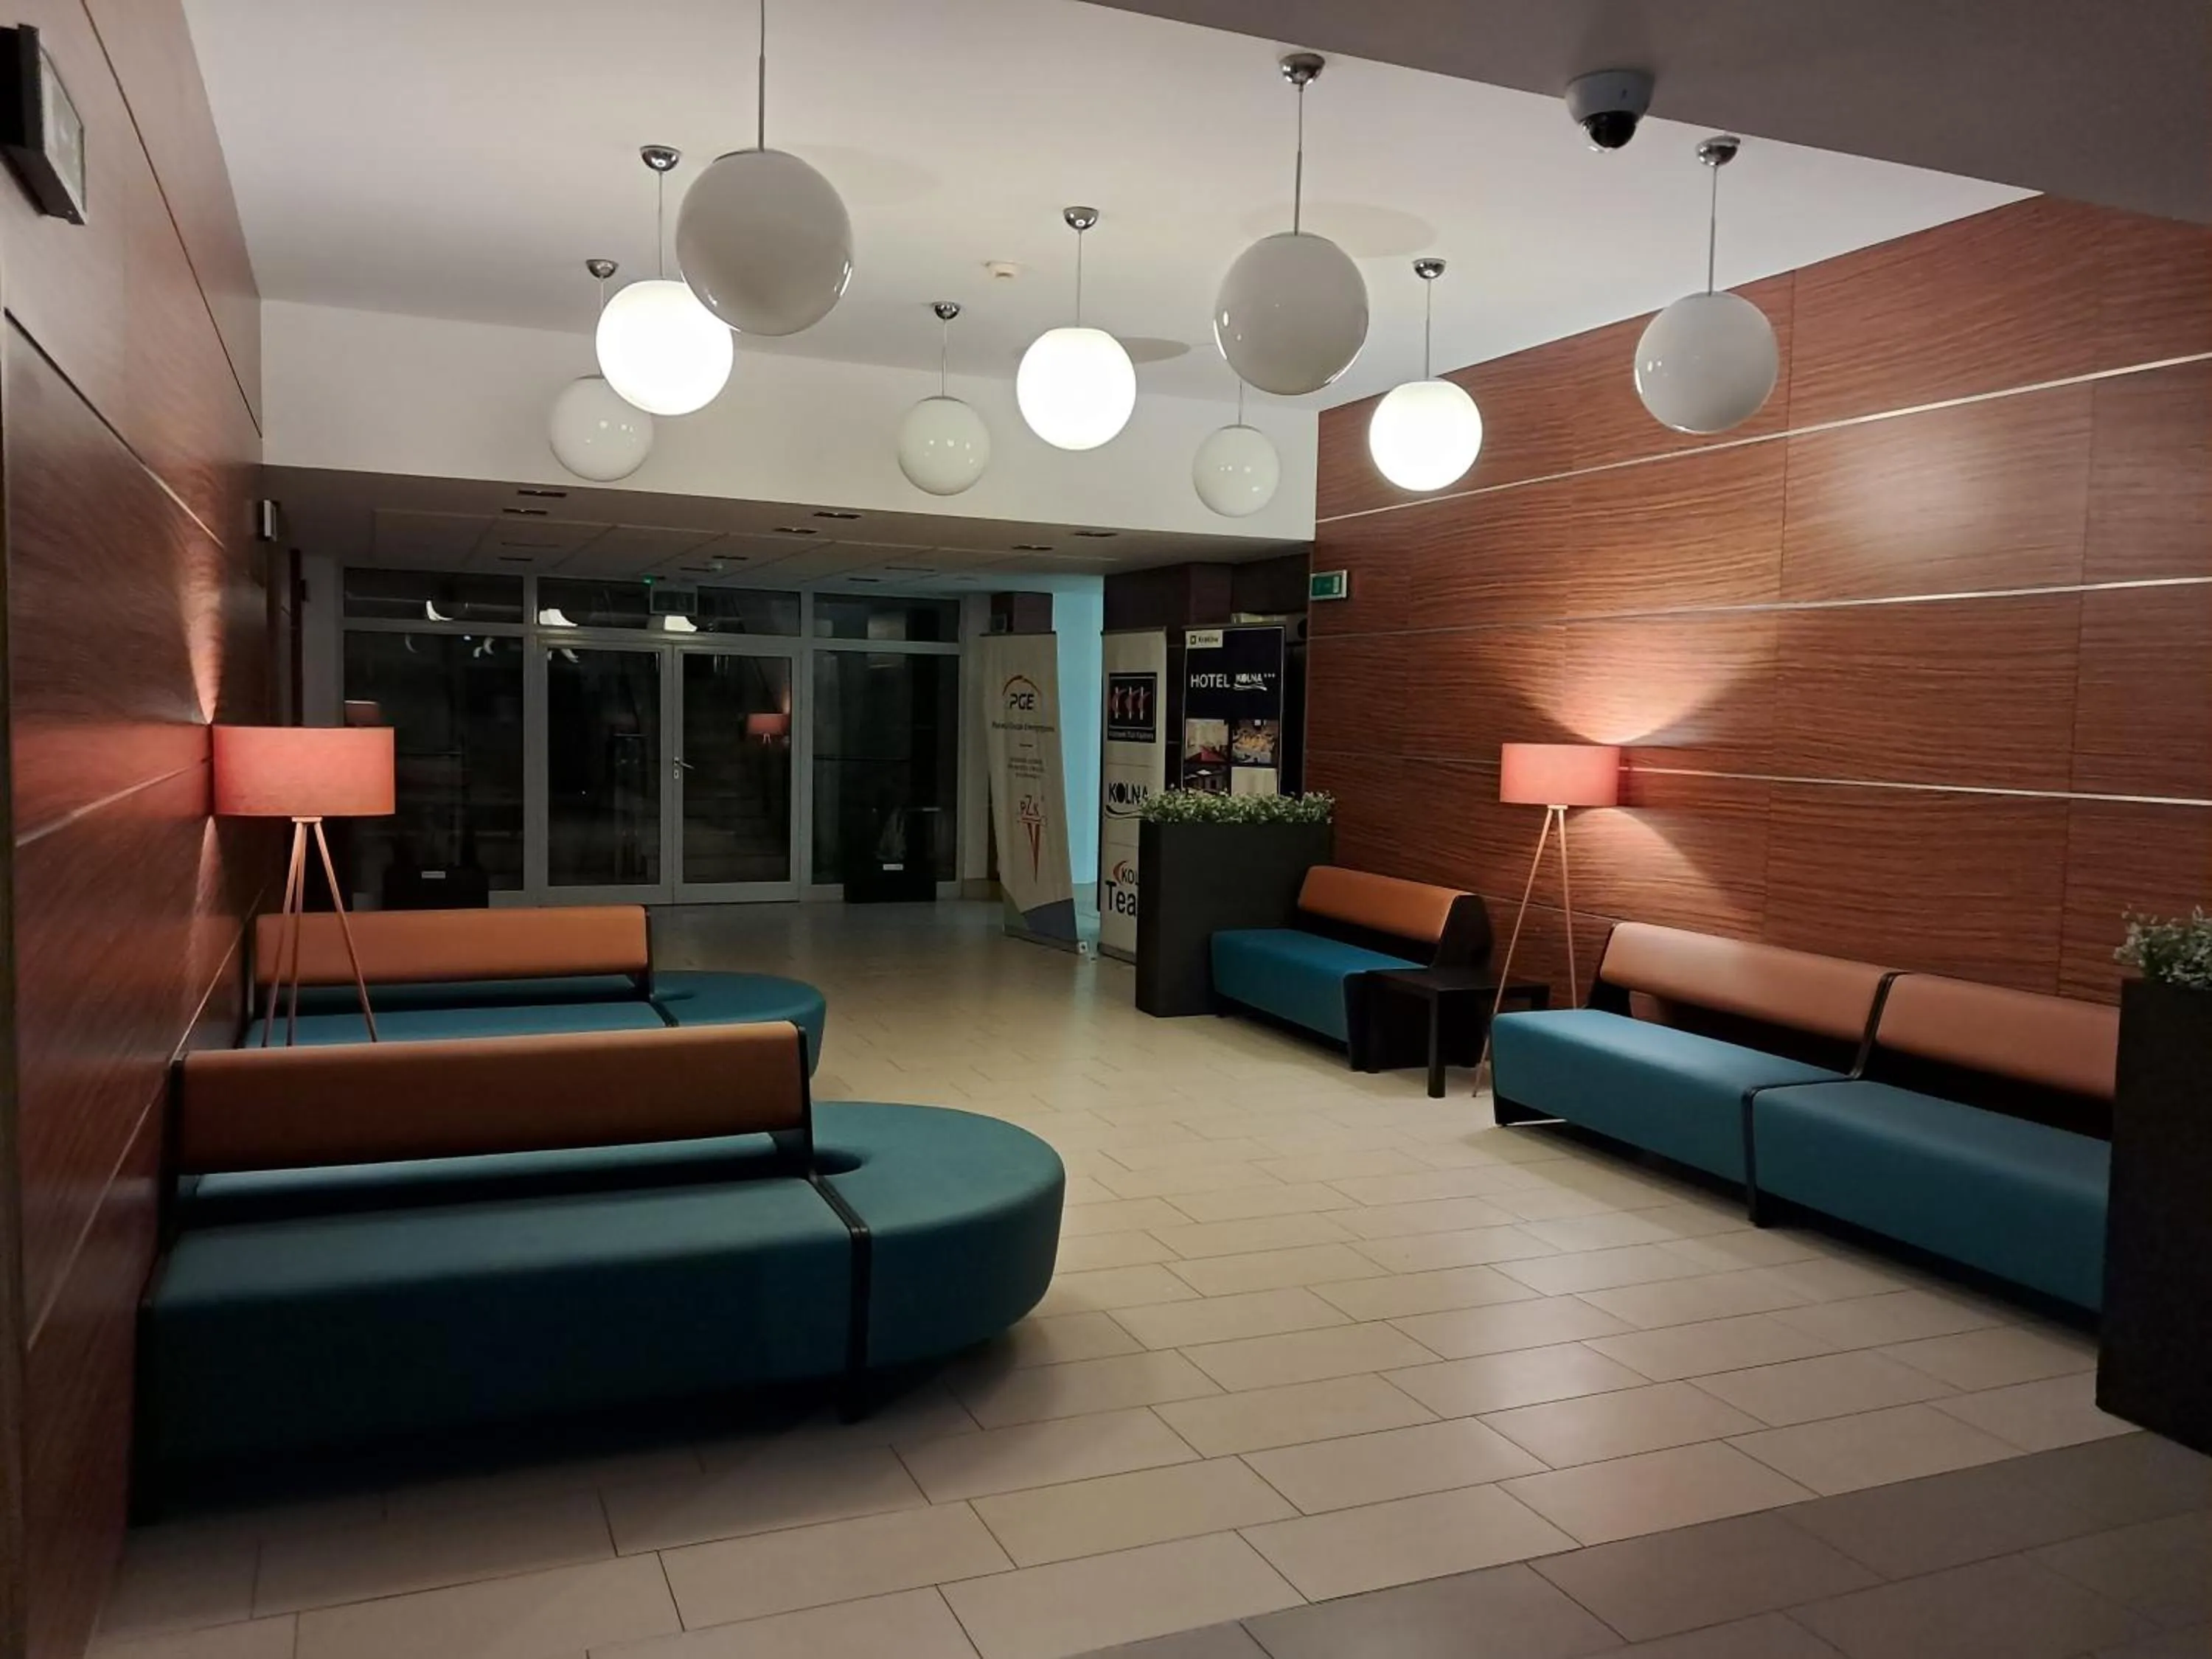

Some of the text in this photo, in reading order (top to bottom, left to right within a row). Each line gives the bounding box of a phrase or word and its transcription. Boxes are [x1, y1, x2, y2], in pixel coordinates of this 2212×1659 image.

[1191, 673, 1263, 688] HOTEL KOLNA
[1009, 693, 1034, 709] PGE
[1108, 782, 1148, 804] KOLNA
[1105, 880, 1136, 917] Tea
